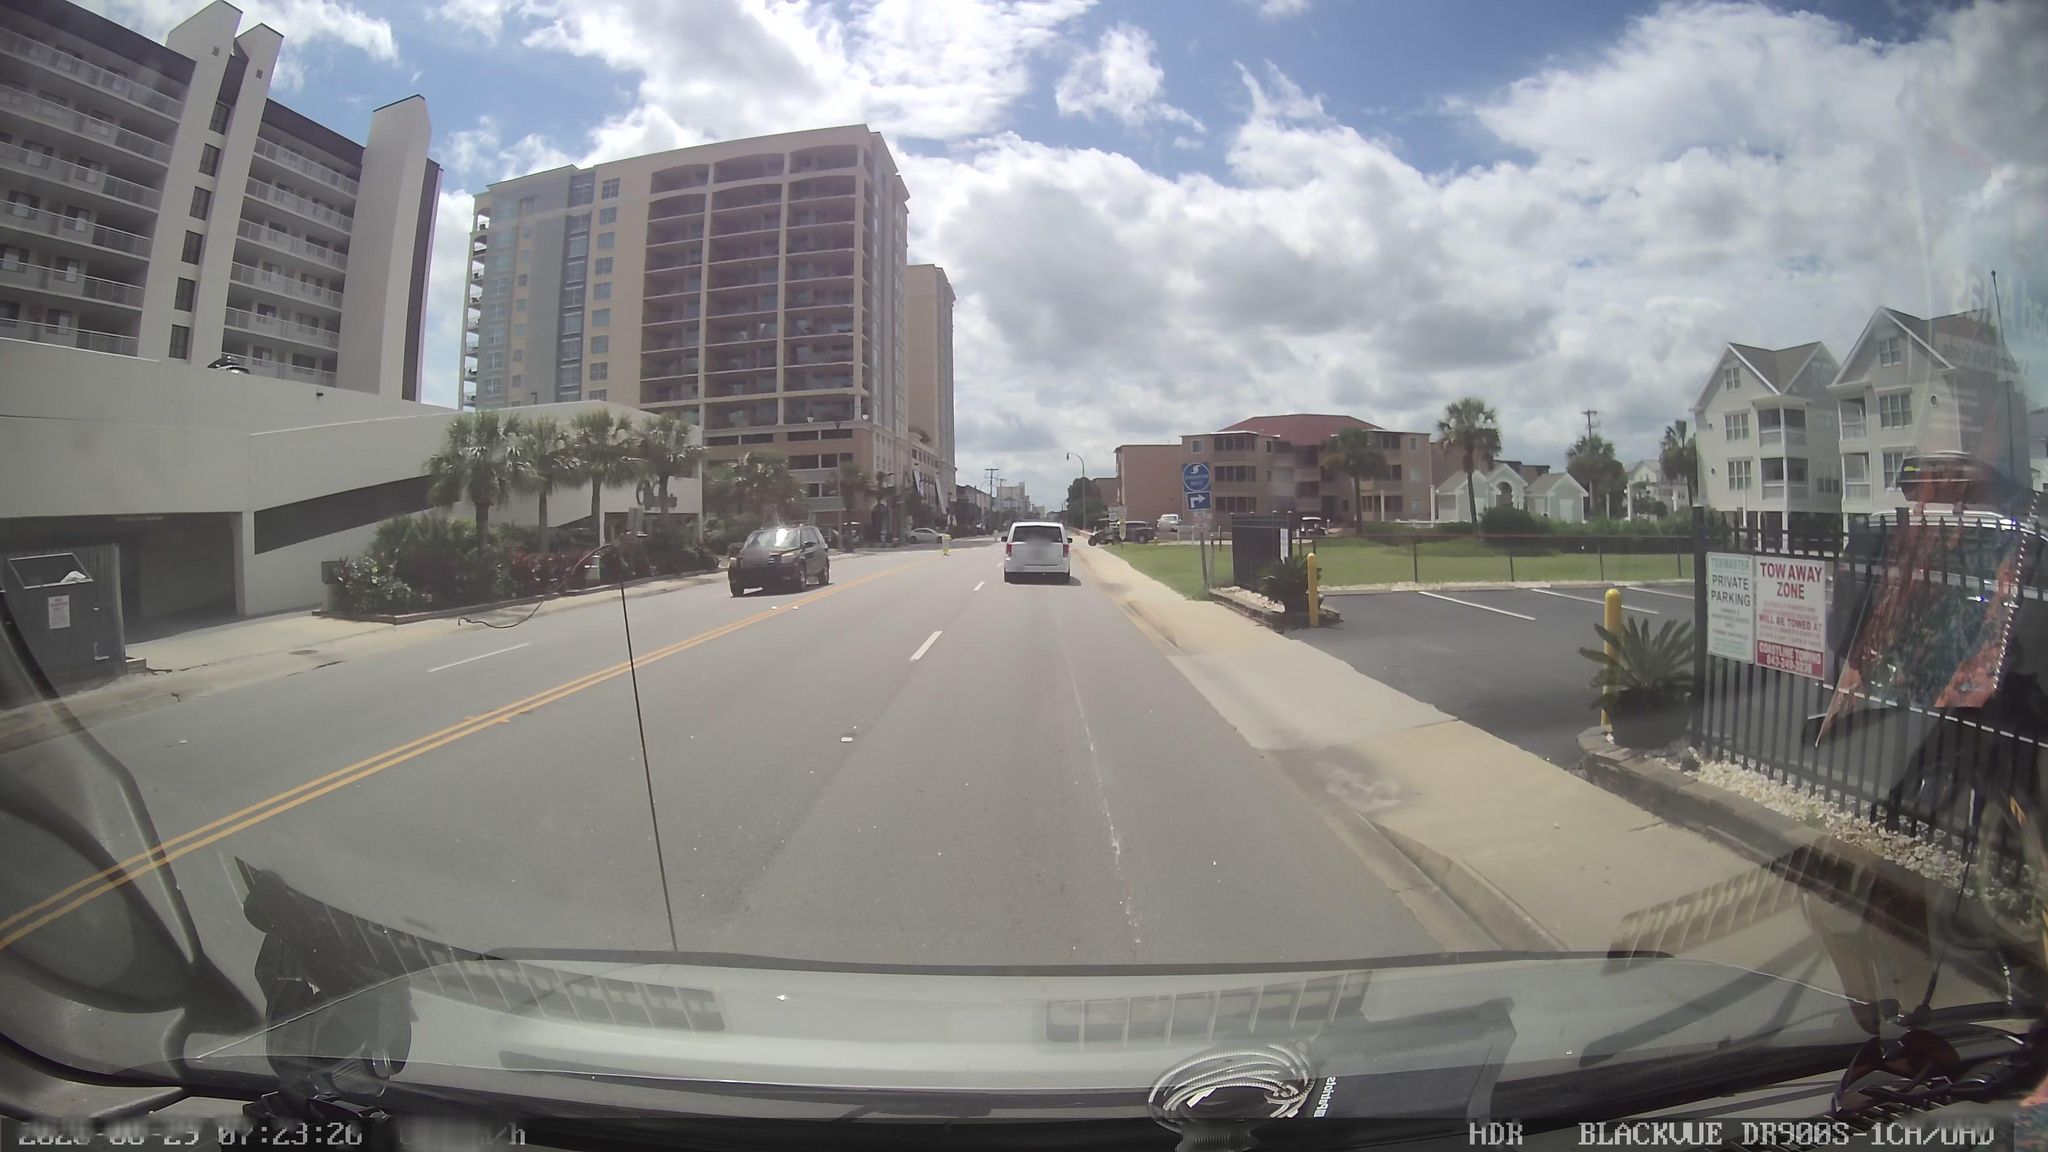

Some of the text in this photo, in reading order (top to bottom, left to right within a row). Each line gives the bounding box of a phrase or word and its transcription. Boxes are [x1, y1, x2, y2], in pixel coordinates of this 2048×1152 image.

[1760, 562, 1822, 583] TOW AWAY
[1712, 574, 1749, 591] PRIVATE
[1777, 581, 1805, 600] ZONE
[1711, 590, 1751, 607] PARKING
[1759, 614, 1774, 625] WILL
[1776, 616, 1785, 626] BE
[1787, 618, 1811, 631] TOWED
[1812, 623, 1823, 633] AT
